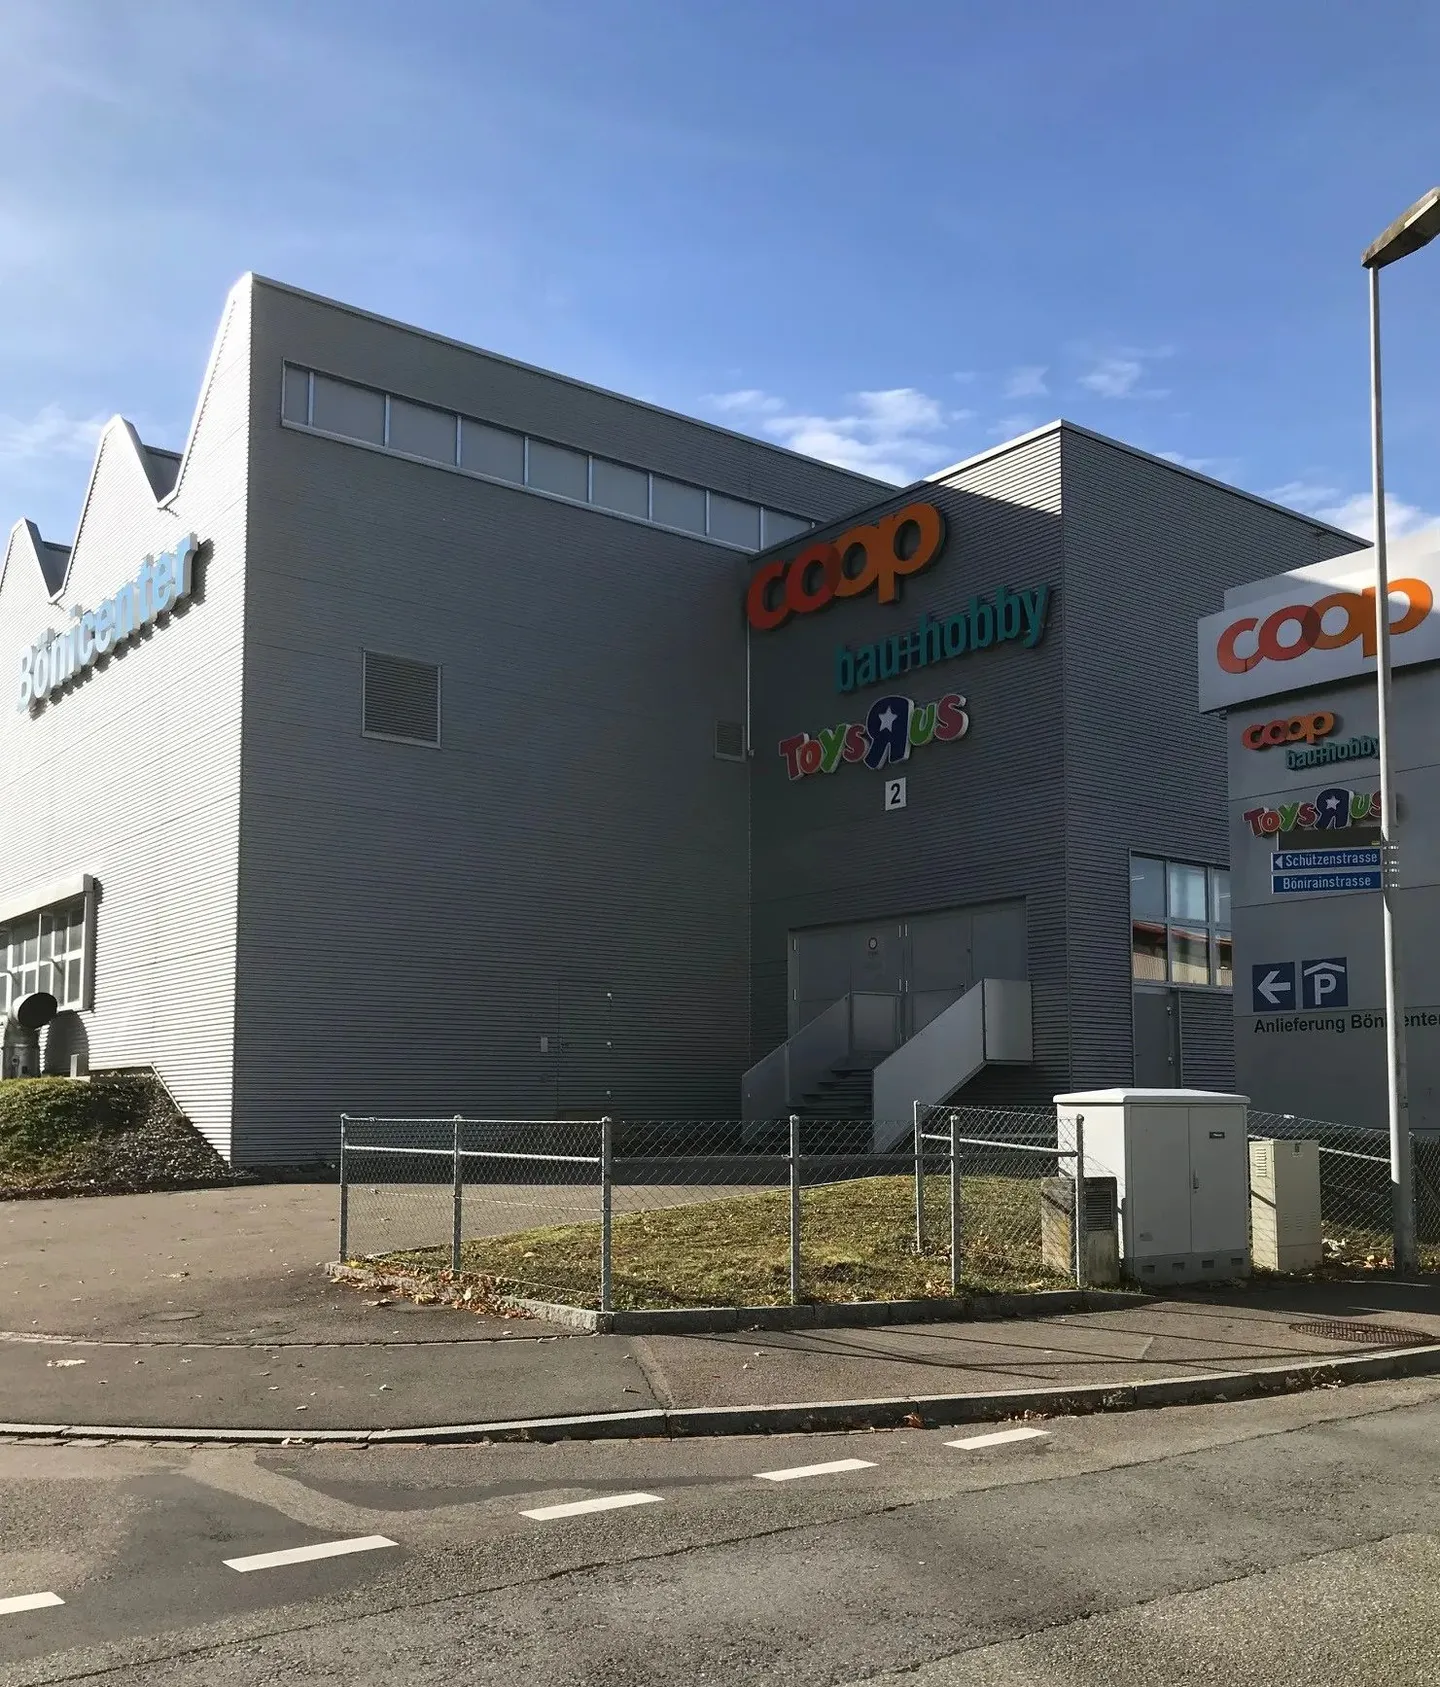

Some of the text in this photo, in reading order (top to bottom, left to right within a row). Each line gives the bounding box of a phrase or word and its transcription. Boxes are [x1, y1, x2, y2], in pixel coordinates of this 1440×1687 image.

[747, 502, 942, 629] coop
[18, 532, 198, 712] Bönicenter
[834, 583, 1049, 693] bau+hobby
[1217, 578, 1433, 674] coop
[1242, 711, 1335, 750] coop
[890, 783, 901, 804] 2
[1285, 852, 1378, 868] Schützenstrasse
[1283, 876, 1372, 890] Bönirainstrasse
[1314, 973, 1337, 1005] P
[1254, 1012, 1440, 1033] Anlieferung Bönente
